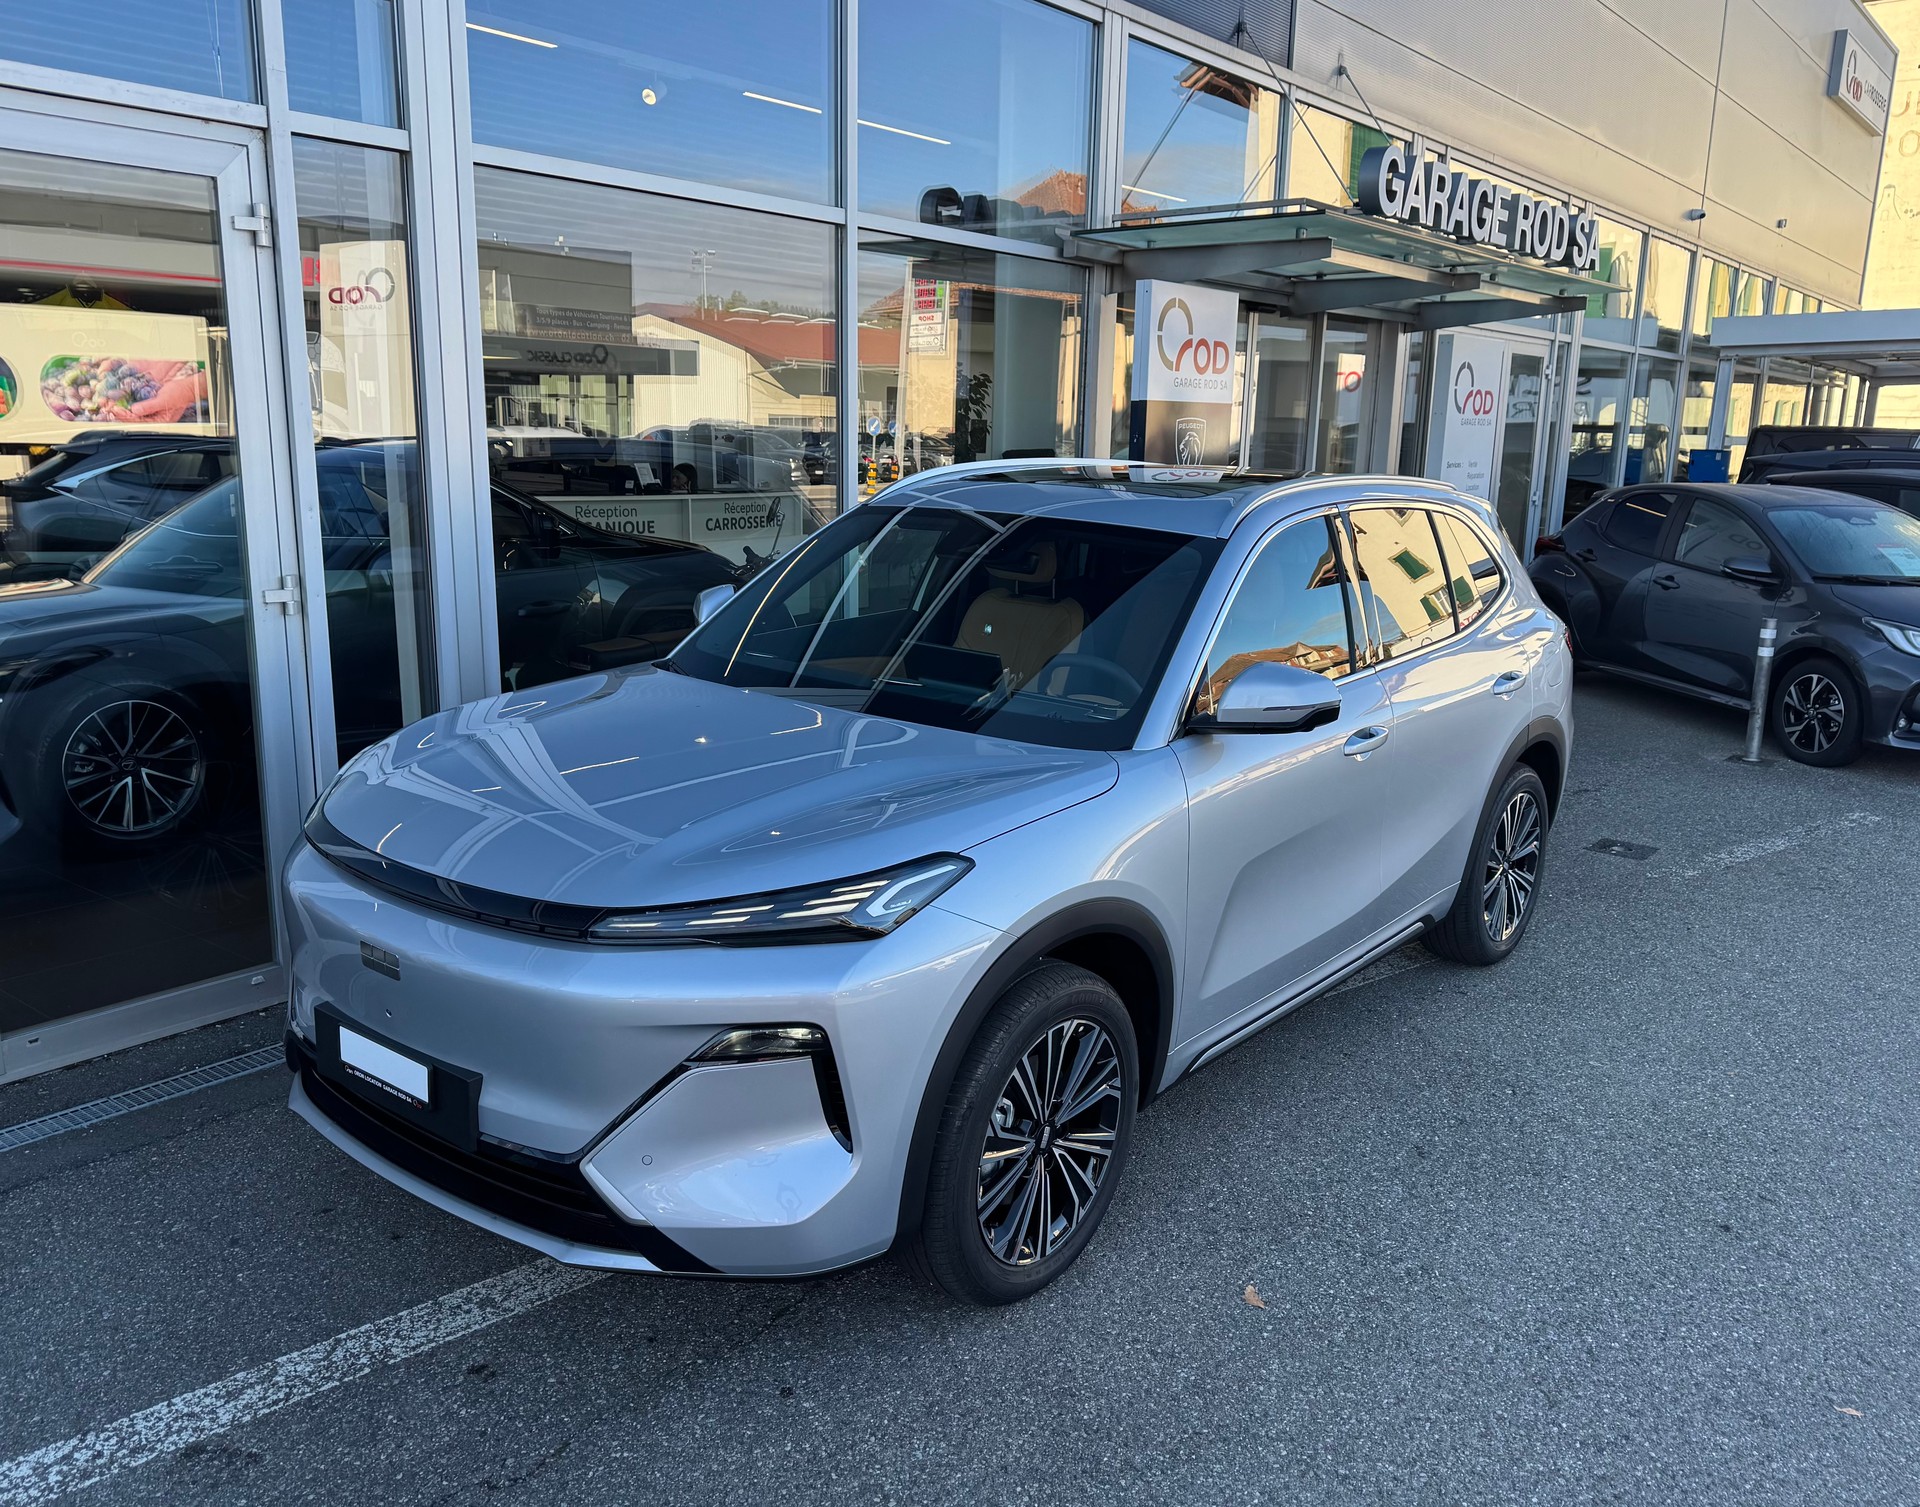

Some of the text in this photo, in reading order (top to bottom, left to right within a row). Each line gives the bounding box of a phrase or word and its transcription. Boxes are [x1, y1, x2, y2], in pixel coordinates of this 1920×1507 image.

[1378, 145, 1600, 272] GARAGE ROD SA
[1173, 376, 1228, 391] GARAGE ROD SA
[1460, 418, 1477, 426] GARAGE
[575, 505, 638, 520] Réception
[724, 501, 767, 515] Réception
[705, 514, 783, 531] CARROSSERIE
[364, 1074, 382, 1088] LOCATION
[382, 1084, 398, 1096] GARAGE
[397, 1091, 407, 1101] ROD
